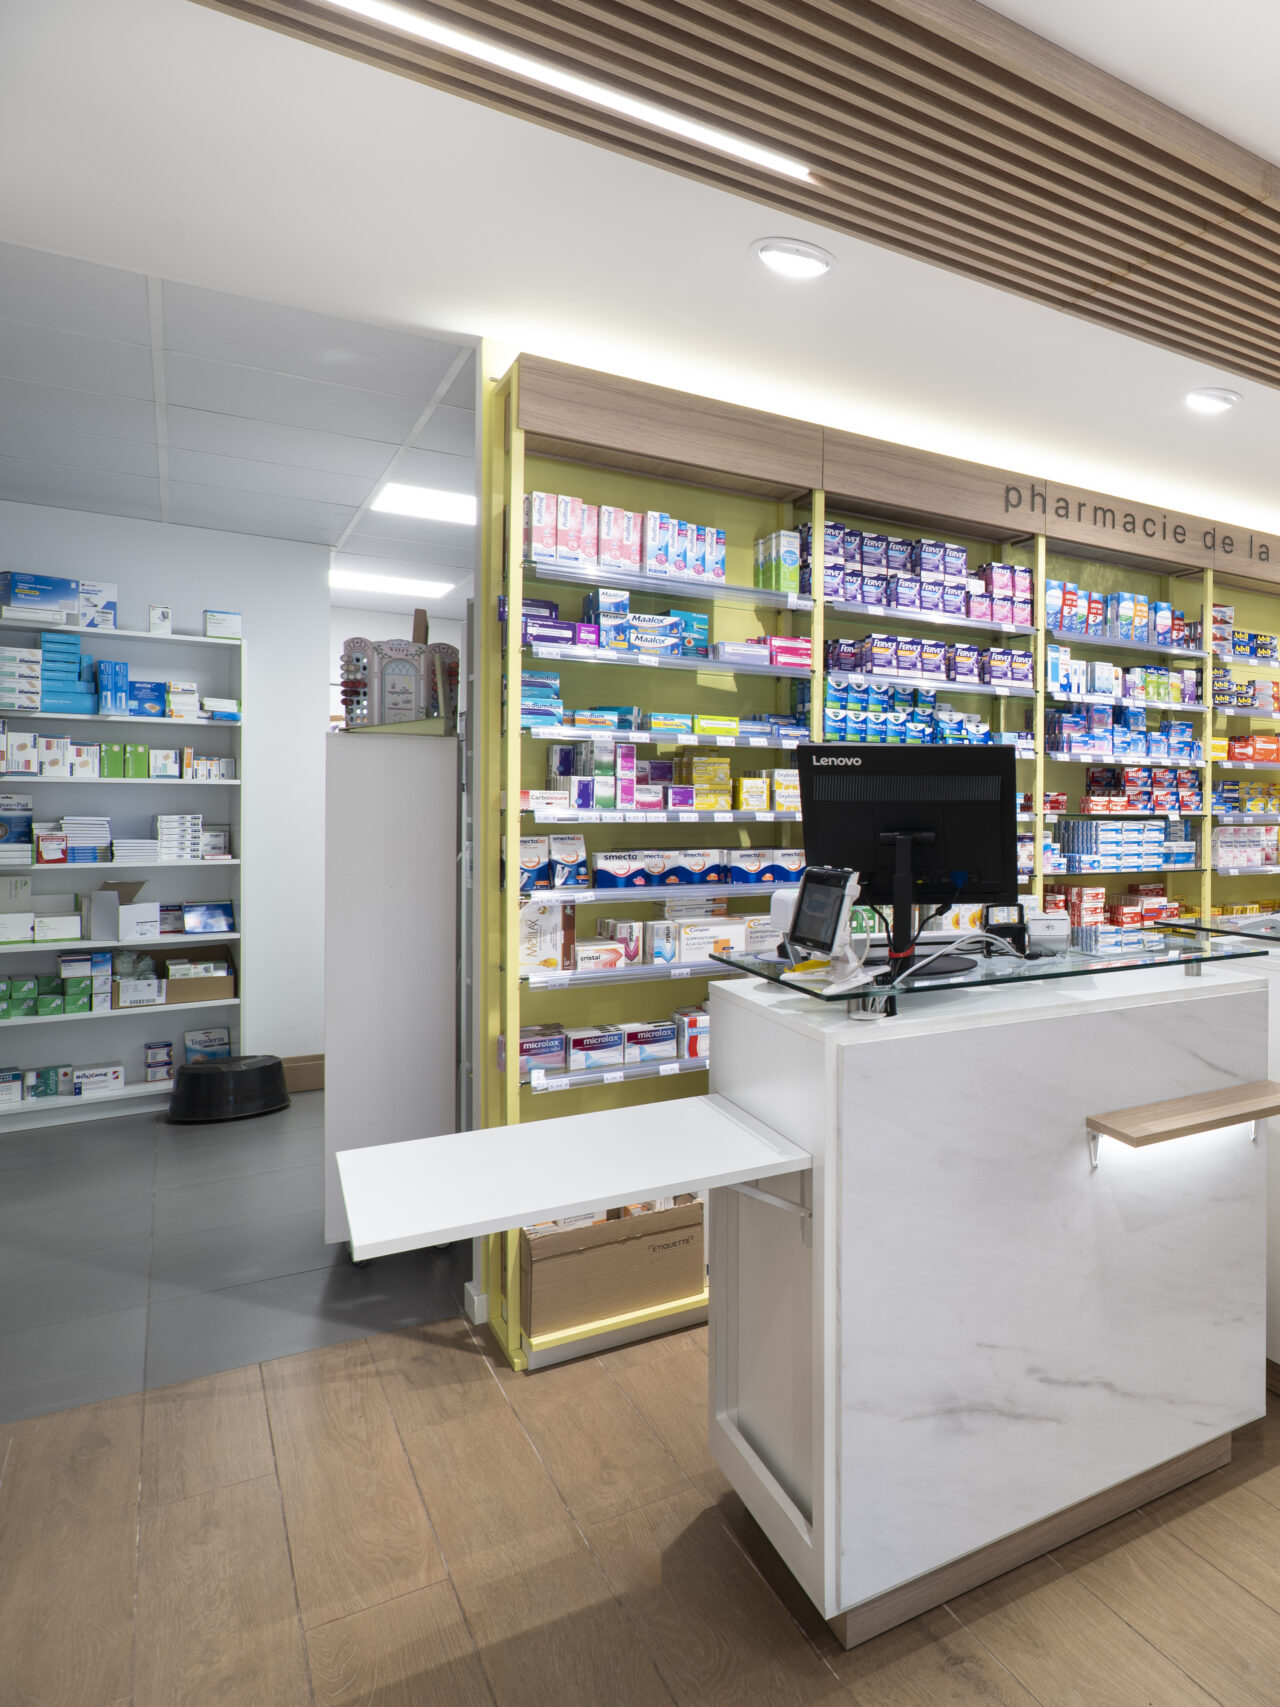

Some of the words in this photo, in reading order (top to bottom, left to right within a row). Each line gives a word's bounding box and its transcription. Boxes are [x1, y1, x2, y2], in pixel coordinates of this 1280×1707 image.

[1004, 484, 1187, 544] pharmacie
[1203, 527, 1235, 554] de
[1249, 535, 1270, 562] la
[823, 527, 845, 538] ERVEX
[863, 537, 887, 549] FERVEX
[889, 542, 911, 553] FERVEX
[921, 544, 944, 554] FERVEX
[945, 548, 967, 559] FERVEX
[823, 568, 844, 577] ERVEX
[845, 576, 861, 584] RVEX
[863, 577, 887, 587] FERVEX
[898, 578, 920, 589] FERVEX
[921, 583, 944, 593] FERVEX
[944, 586, 965, 596] FERVEX
[1067, 607, 1073, 615] 2
[631, 614, 666, 624] Maalox
[1092, 615, 1098, 623] 2
[634, 634, 668, 645] Maalox
[1175, 631, 1181, 639] 2
[1234, 631, 1249, 640] Advil
[840, 644, 855, 653] FERV
[873, 639, 897, 649] FERVEX
[898, 642, 922, 652] FERVEX
[1235, 644, 1250, 653] Advil
[923, 645, 945, 654] FERVEX
[956, 648, 978, 658] FERVEX
[991, 652, 1012, 662] FERVEX
[1012, 655, 1033, 664] FERVEX
[1214, 694, 1229, 702] Advil
[812, 755, 862, 766] Lenovo
[603, 853, 638, 861] smecta
[580, 954, 600, 962] cristal
[637, 1029, 672, 1039] microlax
[189, 1036, 225, 1048] Tegaderm
[523, 1039, 560, 1050] microlax
[583, 1035, 619, 1046] microlax
[652, 1238, 691, 1253] ETIQUETTE
